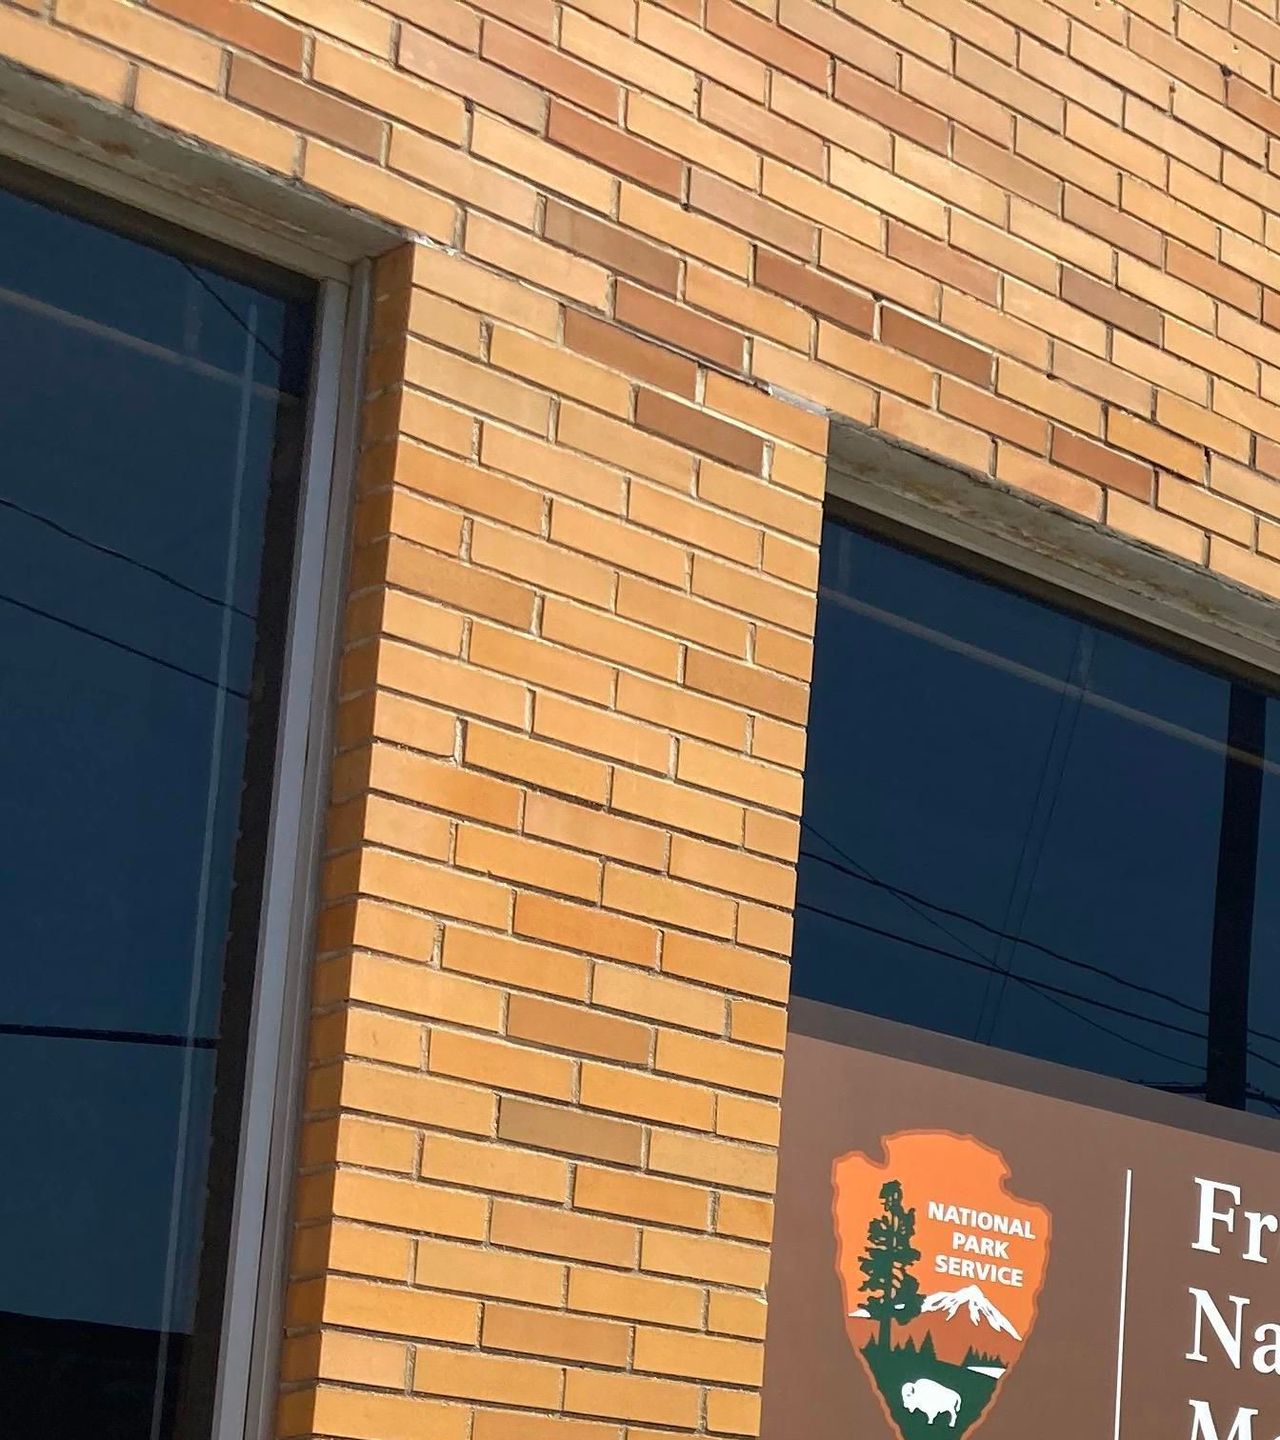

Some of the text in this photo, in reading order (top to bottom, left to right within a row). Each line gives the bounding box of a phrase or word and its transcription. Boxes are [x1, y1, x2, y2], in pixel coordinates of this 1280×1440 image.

[928, 1201, 1036, 1239] NATIONAL
[952, 1231, 1010, 1260] PARK
[935, 1254, 1024, 1288] SERVICE
